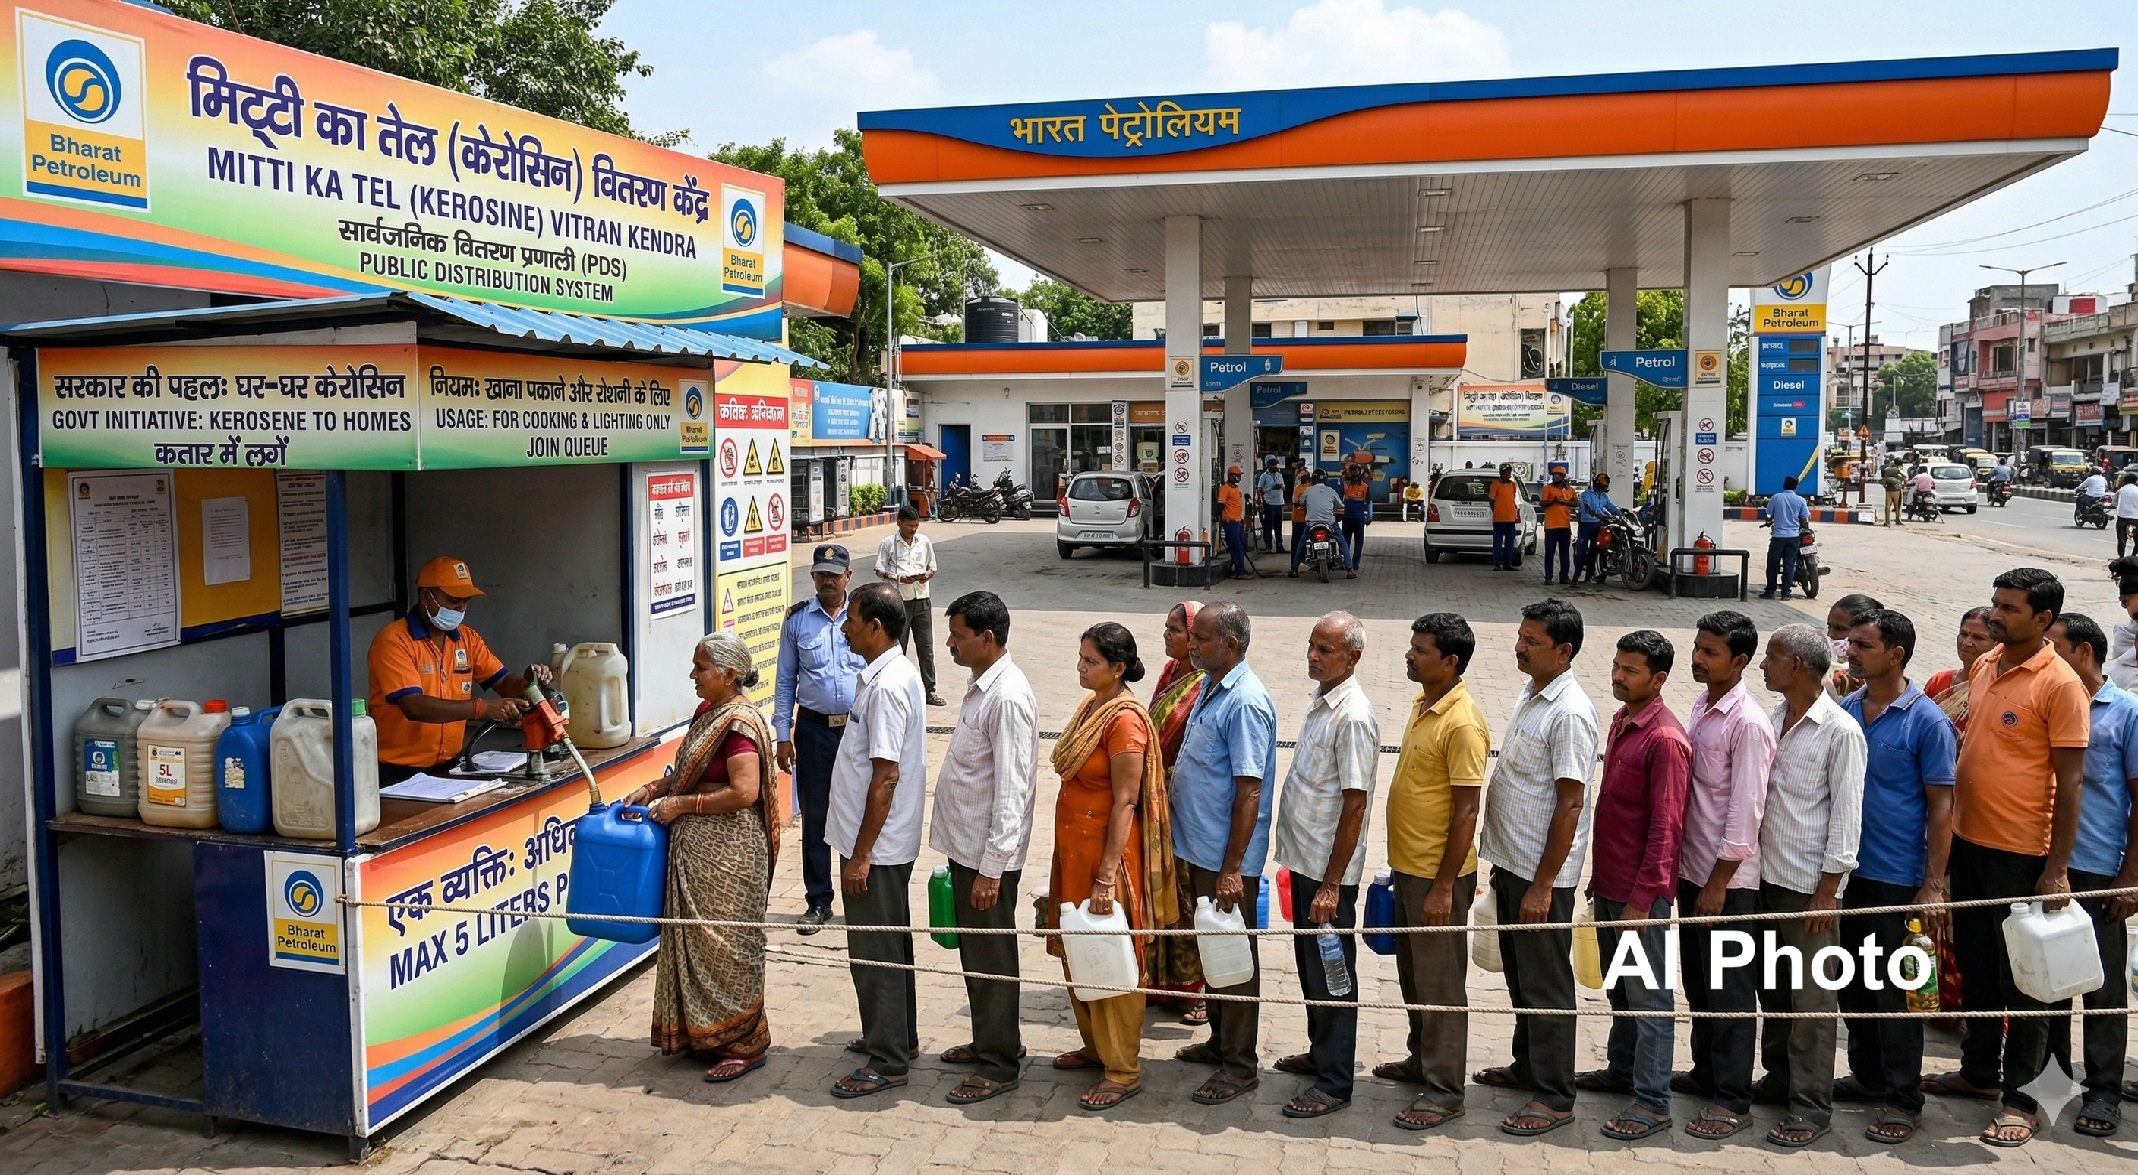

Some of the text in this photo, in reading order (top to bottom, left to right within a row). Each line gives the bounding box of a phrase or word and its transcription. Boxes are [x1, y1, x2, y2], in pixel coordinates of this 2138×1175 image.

[1010, 100, 1241, 147] भारत पेट्रोलियम
[50, 134, 121, 163] Bharat
[187, 56, 709, 224] मिट्टी का तेल (केरोसिन) वितरण केंद्र
[32, 155, 141, 188] Petroleum
[208, 147, 696, 259] MITTI KA TEL (KEROSINE) VITRAN KENDRA
[338, 217, 626, 282] सार्वजनिक वितरण प्रणाली (PDS)
[731, 255, 755, 269] Bharat
[360, 252, 613, 301] PUBLIC DISTRIBUTION SYSTEM
[724, 267, 762, 283] Petroleum
[1763, 318, 1819, 328] Petroleum
[1773, 308, 1809, 317] Bharat
[1210, 362, 1247, 373] Petrol
[1635, 356, 1675, 368] Petrol
[53, 375, 127, 399] सरकार
[132, 365, 162, 398] की
[314, 364, 406, 399] केरोसिन
[484, 378, 522, 400] खाना
[526, 375, 566, 401] पकाने
[569, 375, 593, 402] और
[596, 377, 632, 404] रोशनी
[634, 380, 647, 404] के
[649, 379, 670, 406] लिए
[1571, 382, 1599, 391] Diesel
[1773, 380, 1804, 390] Diesel
[52, 410, 412, 432] GOVT INITIATIVE: KEROSENE TO HOMES
[436, 408, 671, 430] USAGE: FOR COOKING & LIGHTING ONLY
[154, 434, 290, 467] कतार में लगें
[527, 437, 608, 457] JOIN QUEUE
[159, 764, 172, 776] 5L
[386, 880, 434, 936] एक
[287, 924, 325, 940] Bharat
[390, 929, 448, 990] MAX
[455, 920, 468, 956] 5
[477, 881, 550, 947] LITERS
[277, 936, 337, 954] Petroleum
